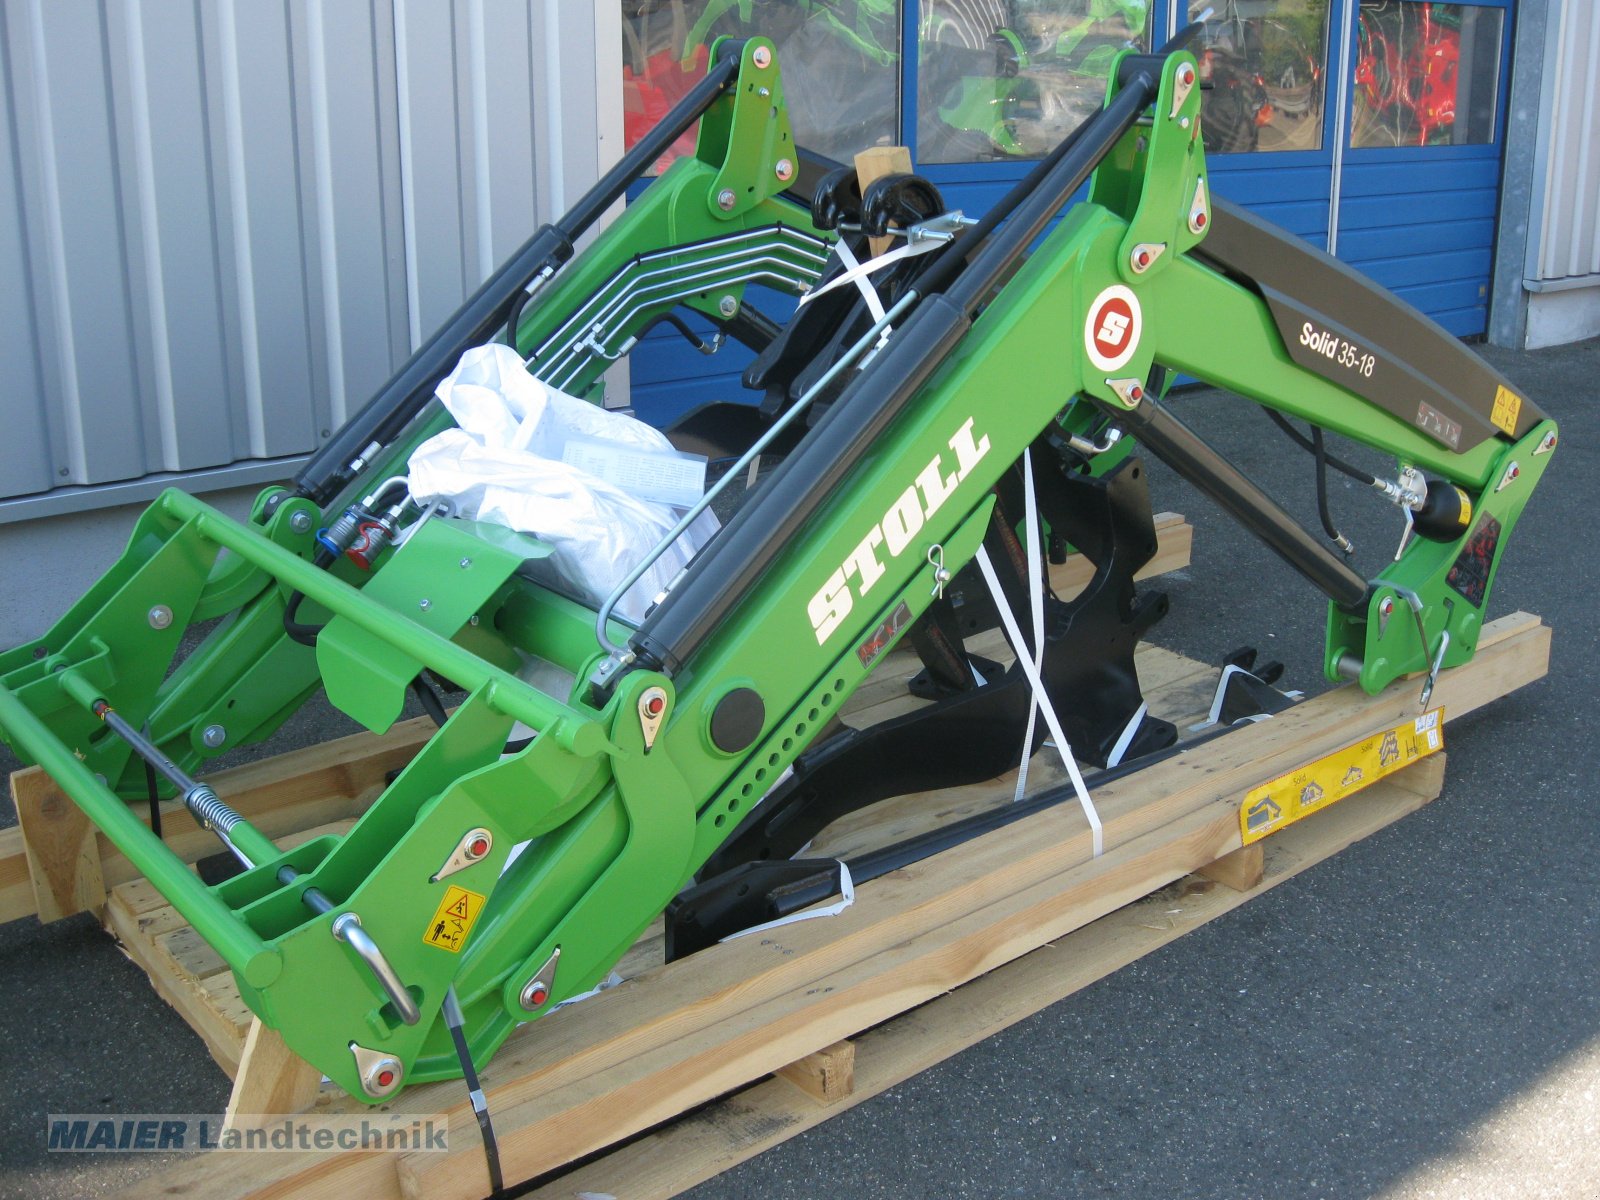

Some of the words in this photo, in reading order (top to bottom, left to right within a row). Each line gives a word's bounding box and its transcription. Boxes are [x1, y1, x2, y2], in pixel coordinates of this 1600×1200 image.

[1300, 322, 1340, 359] Solid
[1337, 341, 1375, 377] 35-18
[807, 416, 991, 646] STOLL
